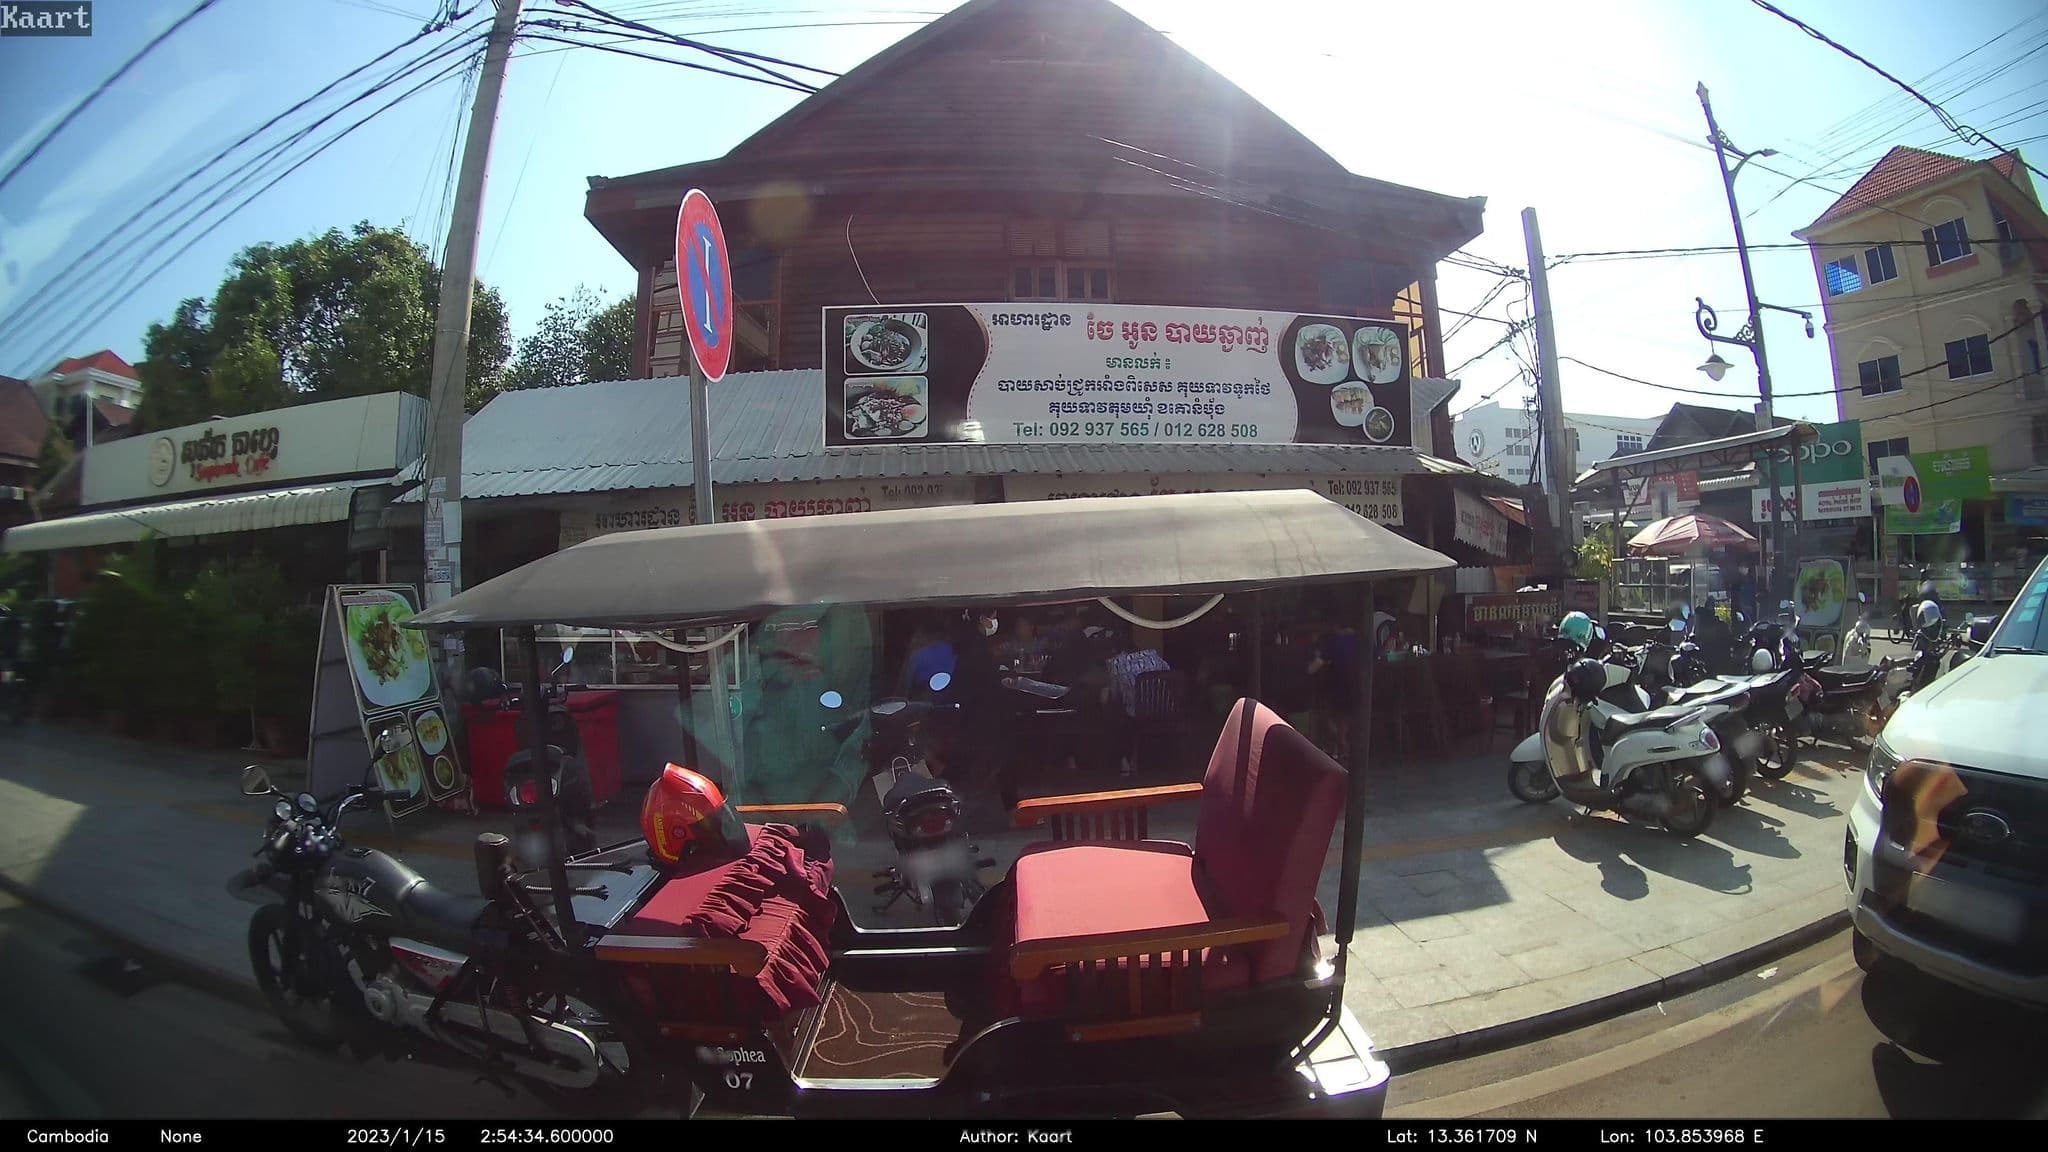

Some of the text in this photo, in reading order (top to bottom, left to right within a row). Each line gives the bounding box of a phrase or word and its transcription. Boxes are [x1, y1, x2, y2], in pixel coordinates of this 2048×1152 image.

[1013, 422, 1043, 437] Tel:
[1049, 422, 1080, 437] 092
[1084, 422, 1115, 437] 937
[1120, 422, 1149, 437] 565
[1164, 422, 1193, 437] 012
[1198, 423, 1226, 438] 628
[1231, 424, 1258, 438] 508
[1328, 479, 1344, 496] Tel:
[1346, 479, 1362, 496] 092
[1364, 479, 1380, 496] 937
[1382, 503, 1398, 519] 508
[725, 1073, 753, 1090] 07
